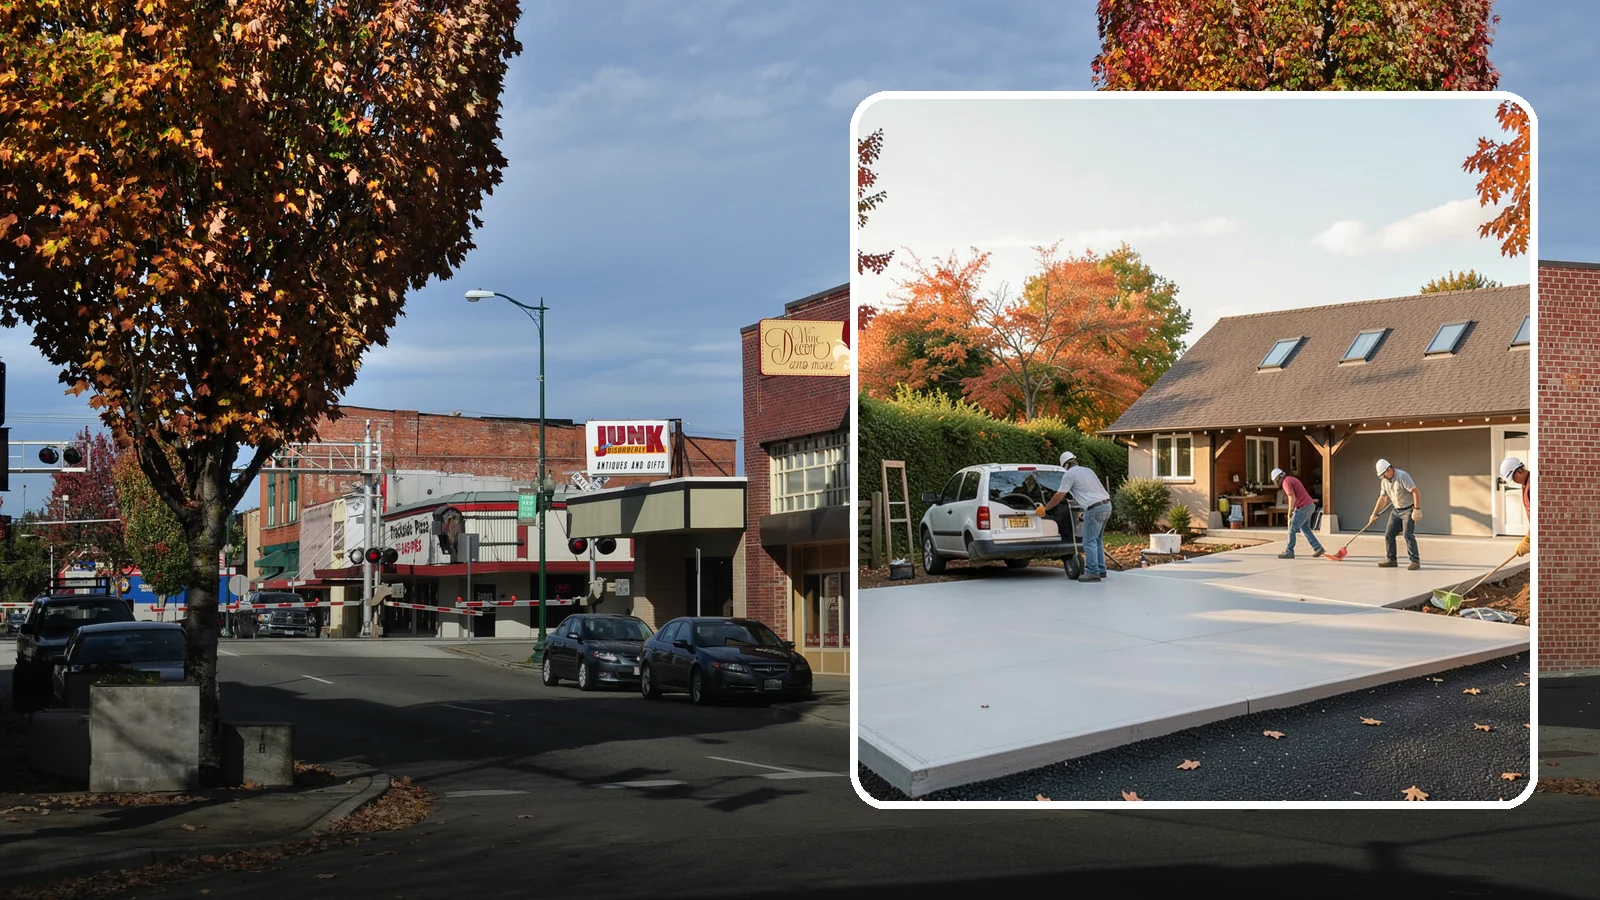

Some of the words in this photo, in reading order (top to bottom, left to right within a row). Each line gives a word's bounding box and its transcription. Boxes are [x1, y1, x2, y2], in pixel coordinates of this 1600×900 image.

[595, 425, 664, 457] JUNK
[607, 446, 646, 454] DISORDERLY
[597, 461, 628, 470] ANTIQUES
[631, 461, 644, 470] AND
[647, 460, 665, 470] GIFTS
[414, 519, 429, 535] Pizza
